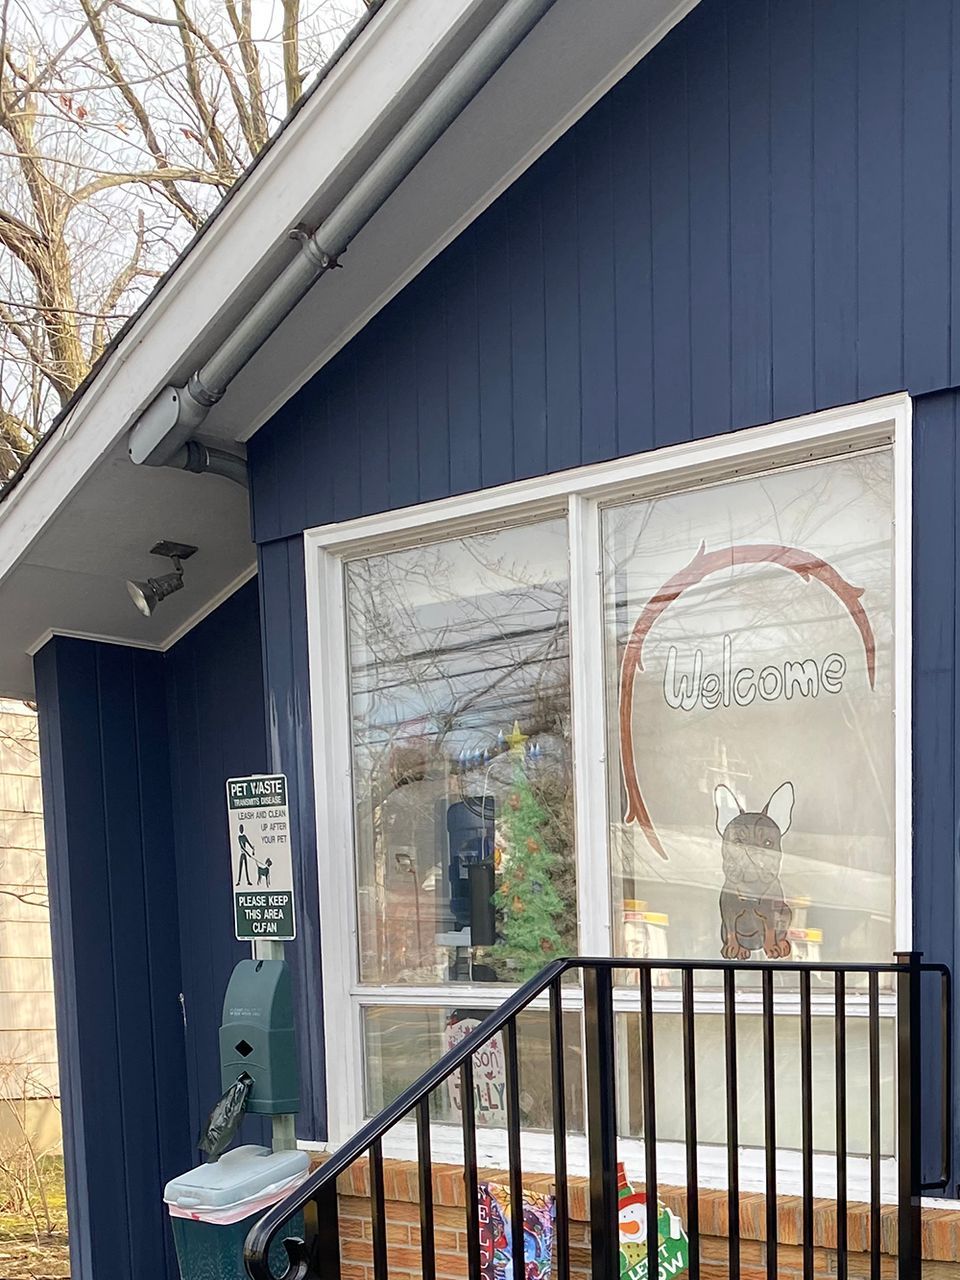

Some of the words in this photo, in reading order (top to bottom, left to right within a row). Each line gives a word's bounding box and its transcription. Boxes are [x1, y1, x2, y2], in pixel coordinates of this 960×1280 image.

[663, 634, 847, 712] Welcome
[231, 783, 248, 796] PET
[250, 780, 283, 795] WASTE
[237, 811, 255, 820] LEASH
[255, 810, 267, 819] AND
[268, 809, 286, 819] CLEAN
[260, 823, 268, 831] UP
[269, 822, 287, 831] AFTER
[261, 835, 276, 844] YOUR
[276, 834, 287, 843] PET
[238, 895, 267, 907] PLEASE
[268, 895, 289, 906] KEEP
[244, 909, 262, 920] THIS
[263, 908, 285, 920] AREA
[252, 922, 278, 933] CLEAN
